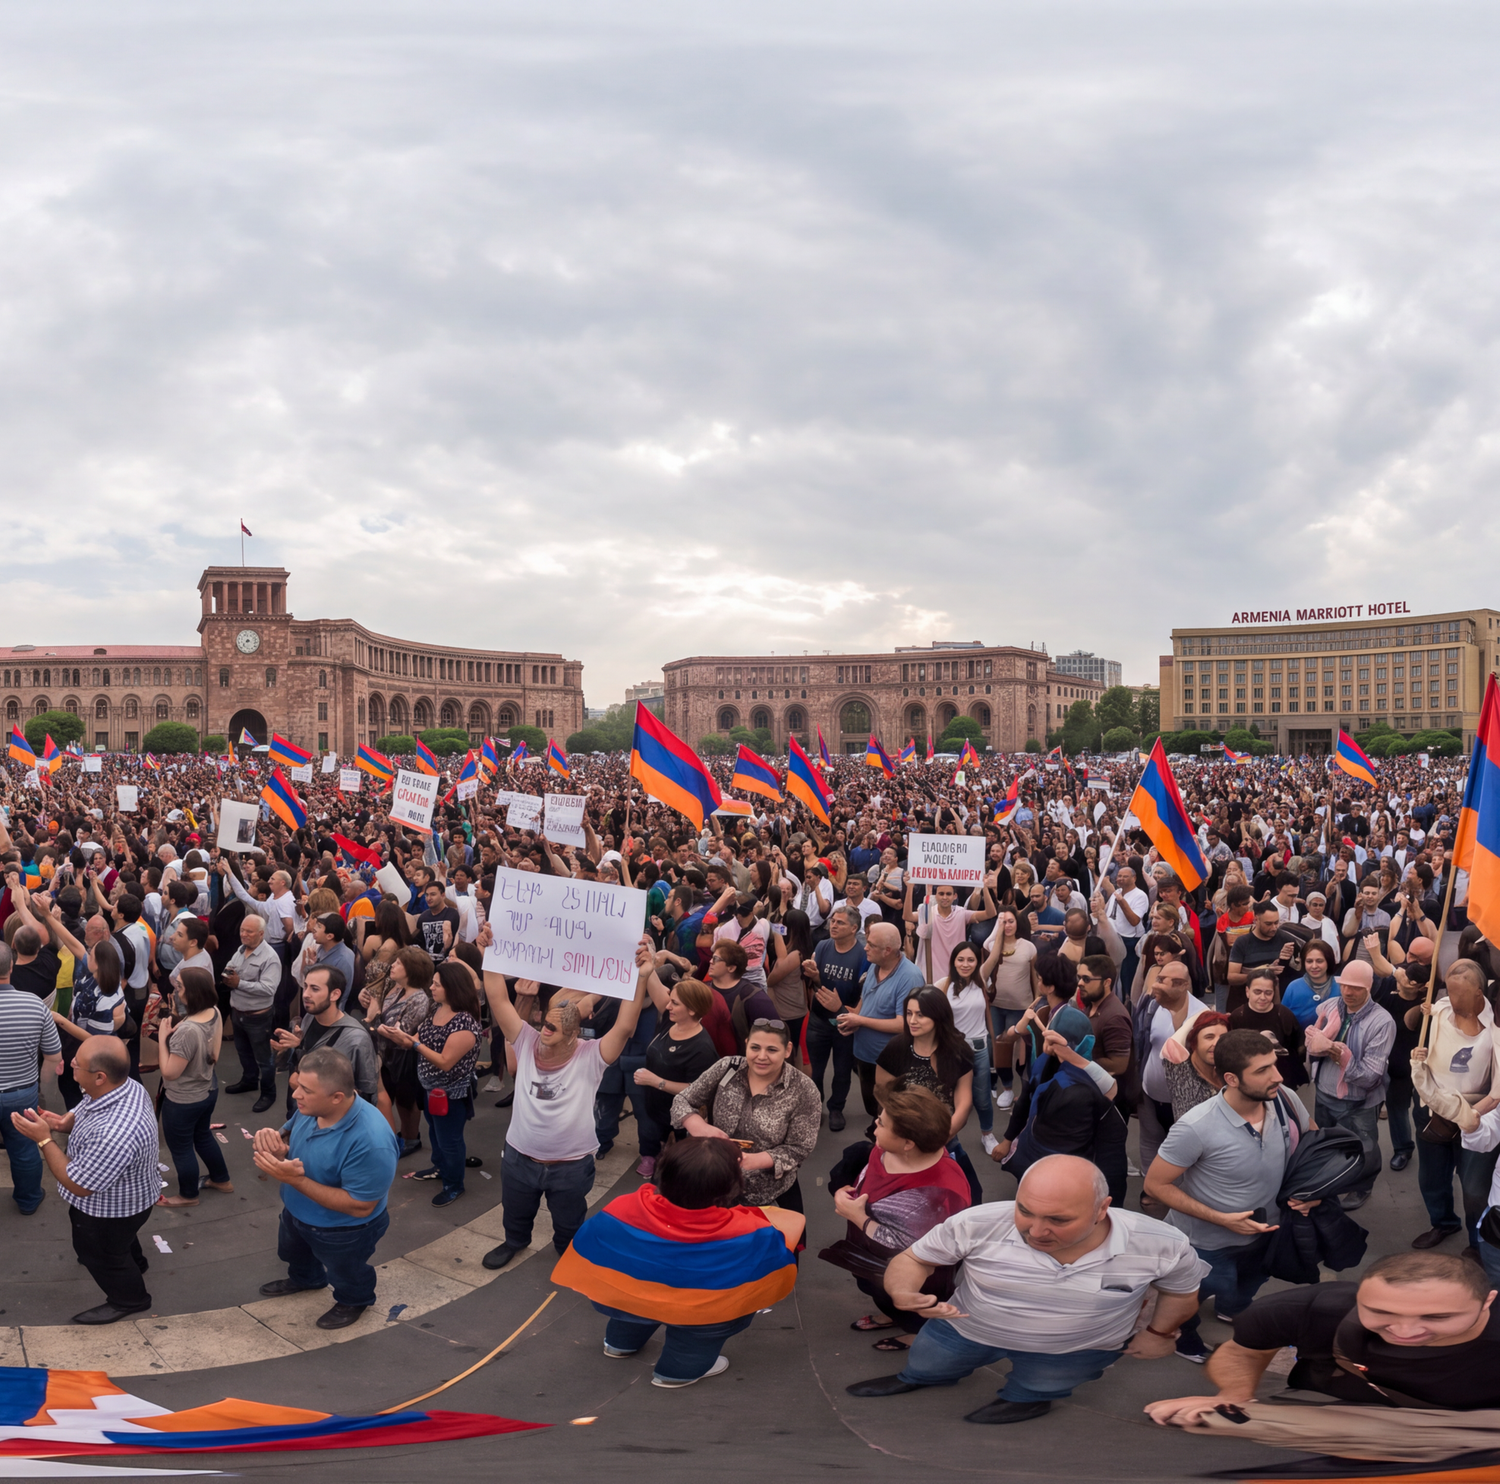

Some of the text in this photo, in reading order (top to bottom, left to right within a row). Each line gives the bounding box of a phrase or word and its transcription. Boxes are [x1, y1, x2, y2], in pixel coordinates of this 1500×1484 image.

[1231, 601, 1410, 624] ARMENIA MARRIOTT HOTEL
